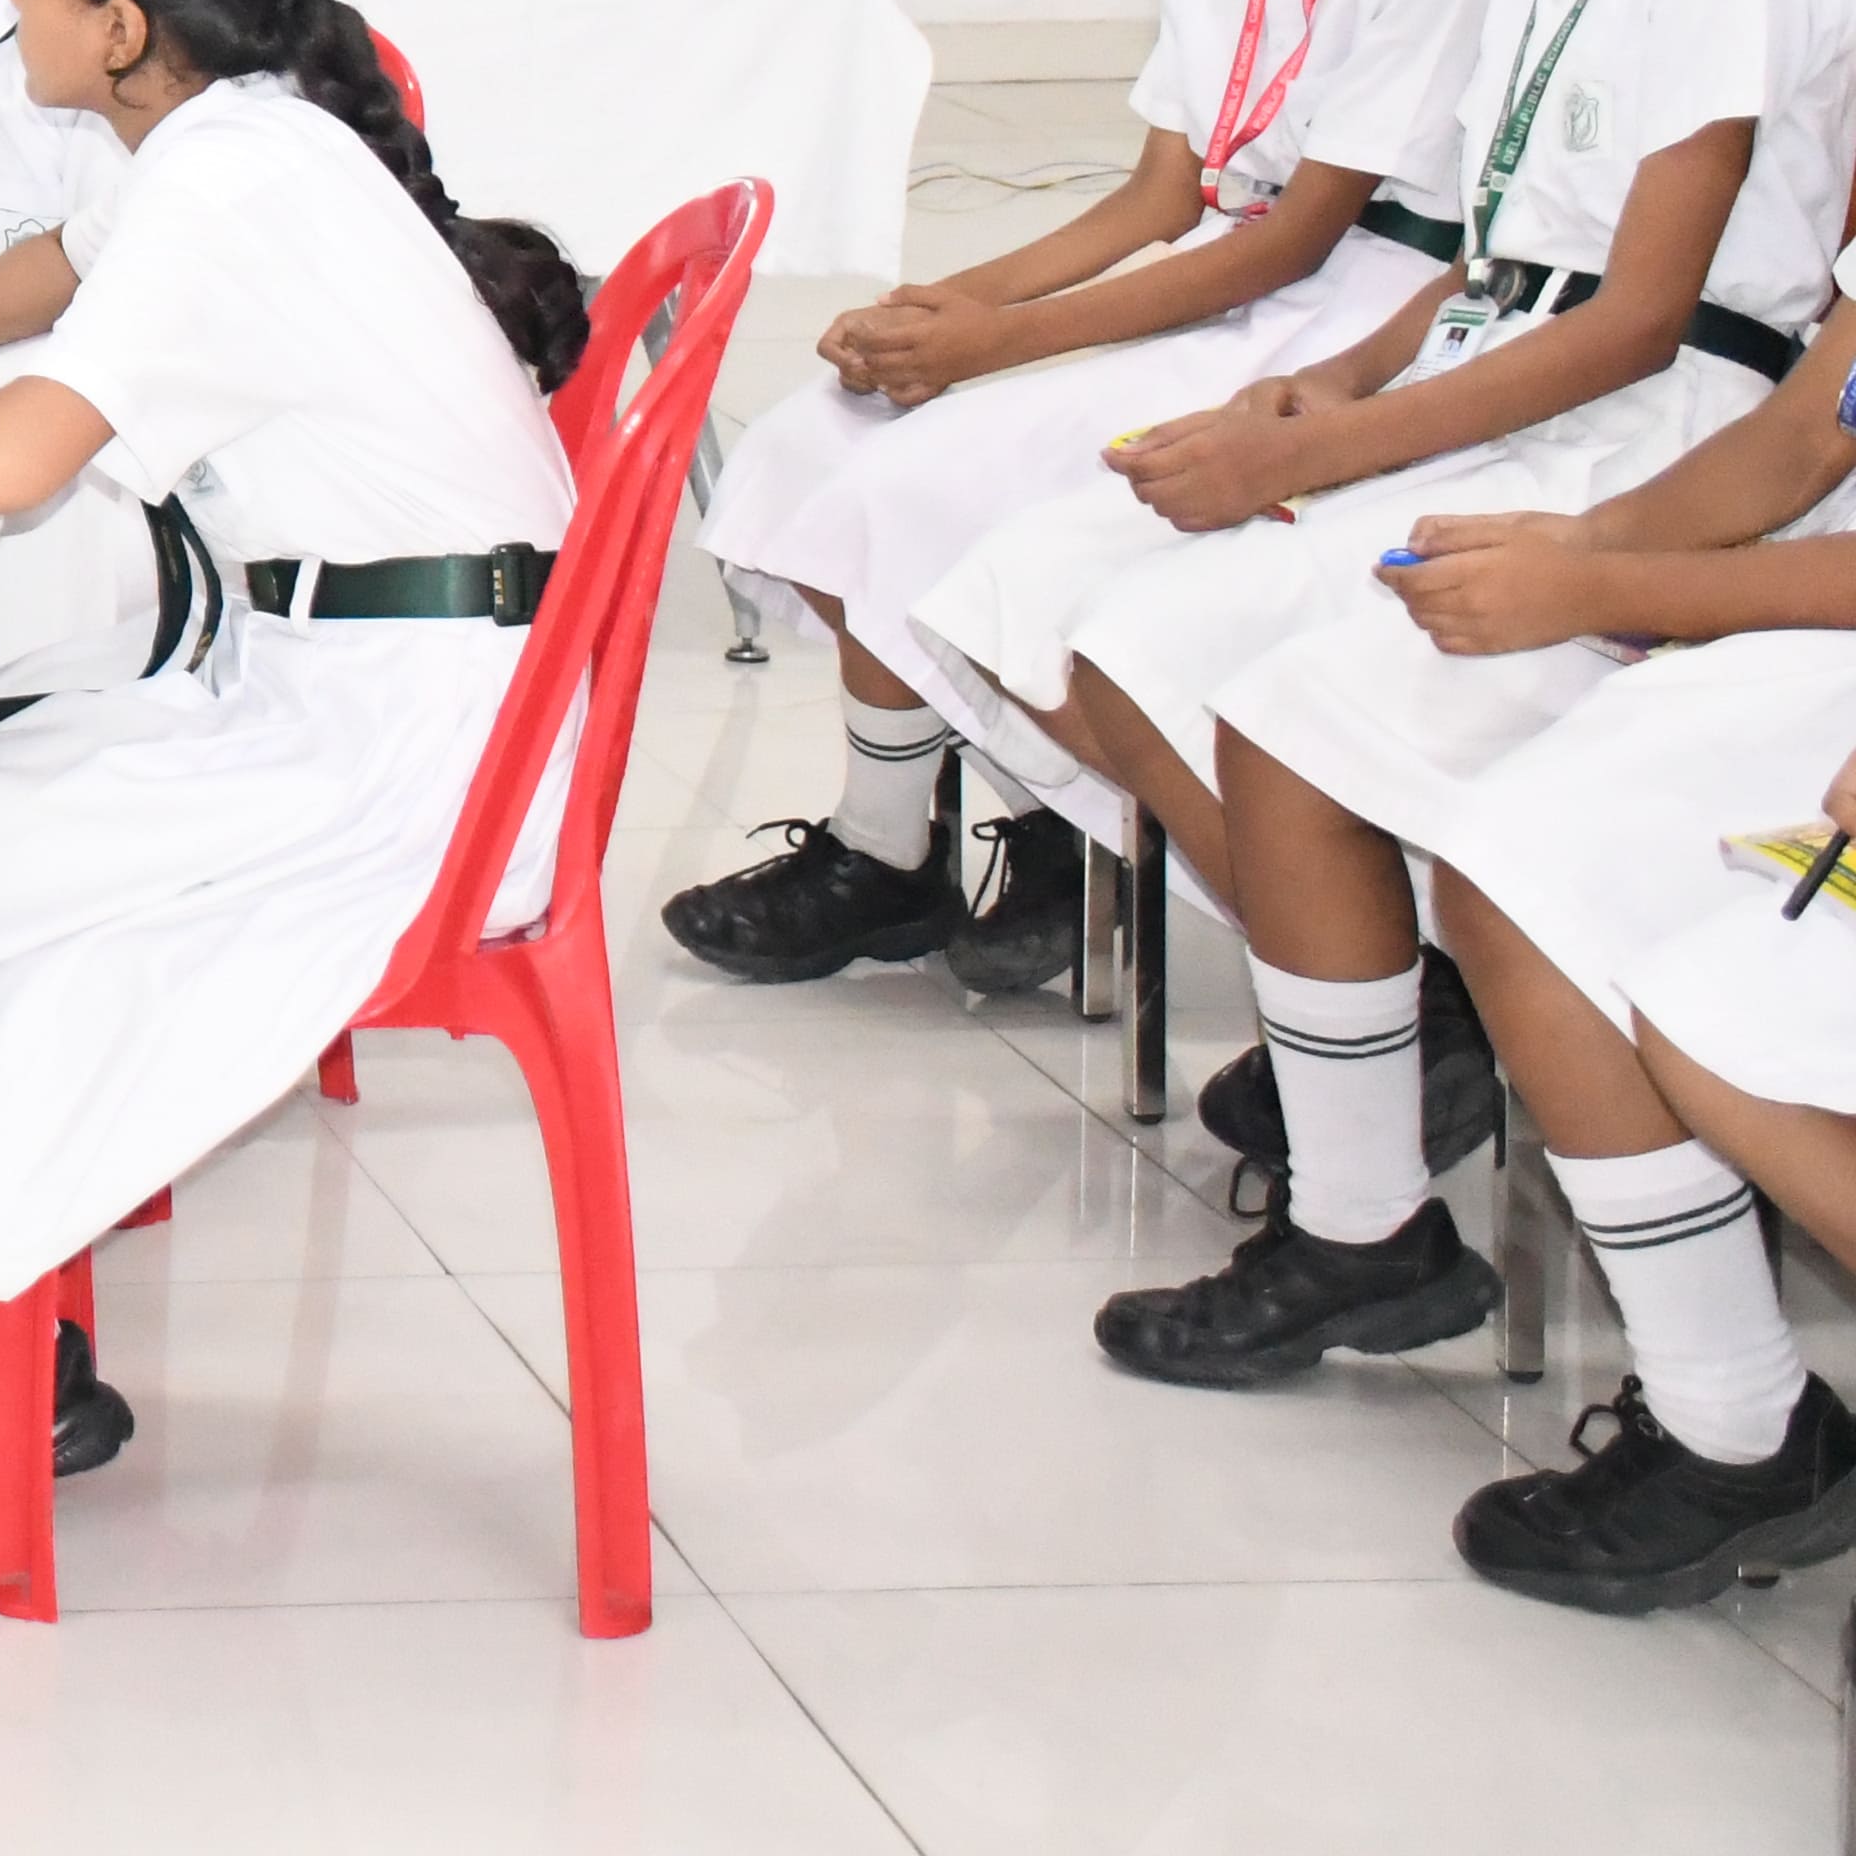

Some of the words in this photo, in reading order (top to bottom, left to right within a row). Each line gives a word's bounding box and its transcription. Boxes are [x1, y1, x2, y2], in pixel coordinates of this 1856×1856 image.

[1222, 84, 1243, 128] PUBLIC
[1502, 123, 1528, 165] DELHI
[1520, 71, 1547, 124] PUBLIC
